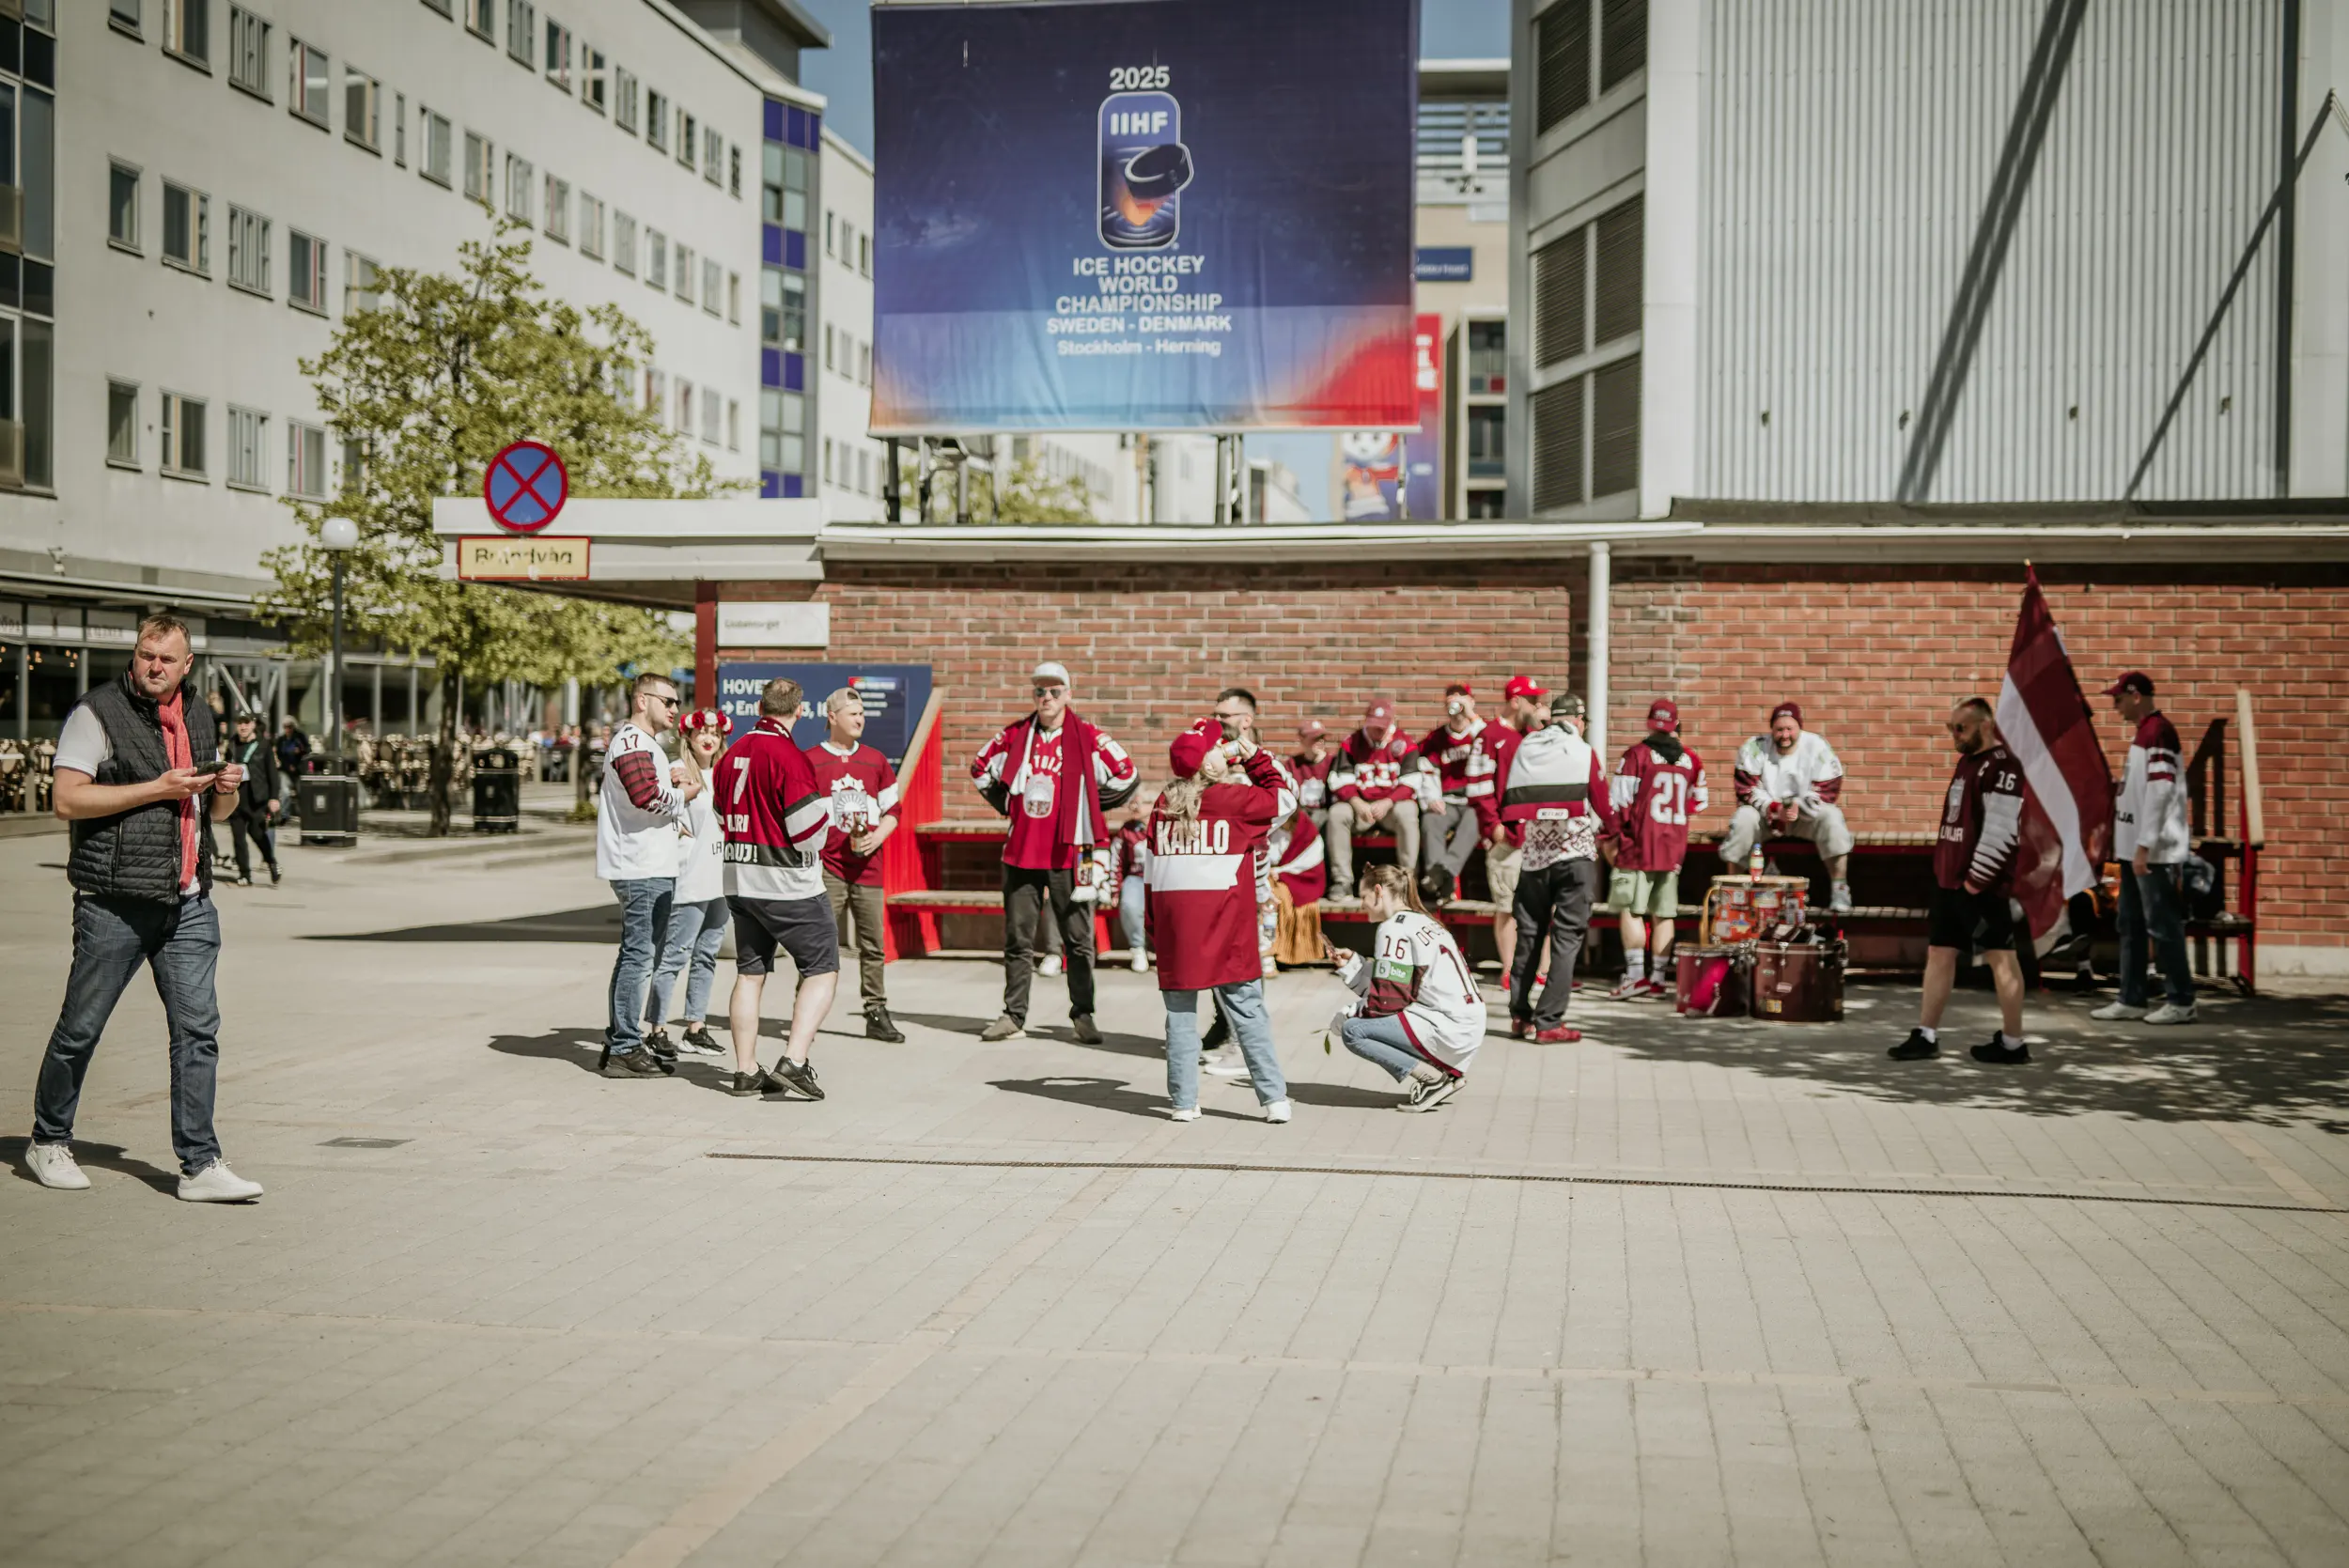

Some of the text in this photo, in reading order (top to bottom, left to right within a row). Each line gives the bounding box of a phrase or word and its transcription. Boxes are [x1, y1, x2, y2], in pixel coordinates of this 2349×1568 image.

[1109, 66, 1171, 90] 2025
[1110, 111, 1168, 136] IIHF
[1072, 255, 1205, 276] ICE HOCKEY
[1097, 275, 1178, 294] WORLD
[1055, 293, 1222, 315] CHAMPIONSHIP
[1047, 317, 1125, 334] SWEDEN
[1138, 315, 1232, 333] DENMARK
[1057, 338, 1143, 356] Stockholm
[1155, 338, 1221, 357] Herning
[620, 733, 640, 752] 17
[733, 756, 751, 805] 7
[1995, 770, 2017, 791] 16
[1650, 771, 1688, 826] 21
[724, 842, 758, 863] AUJ!
[1383, 935, 1409, 960] 16
